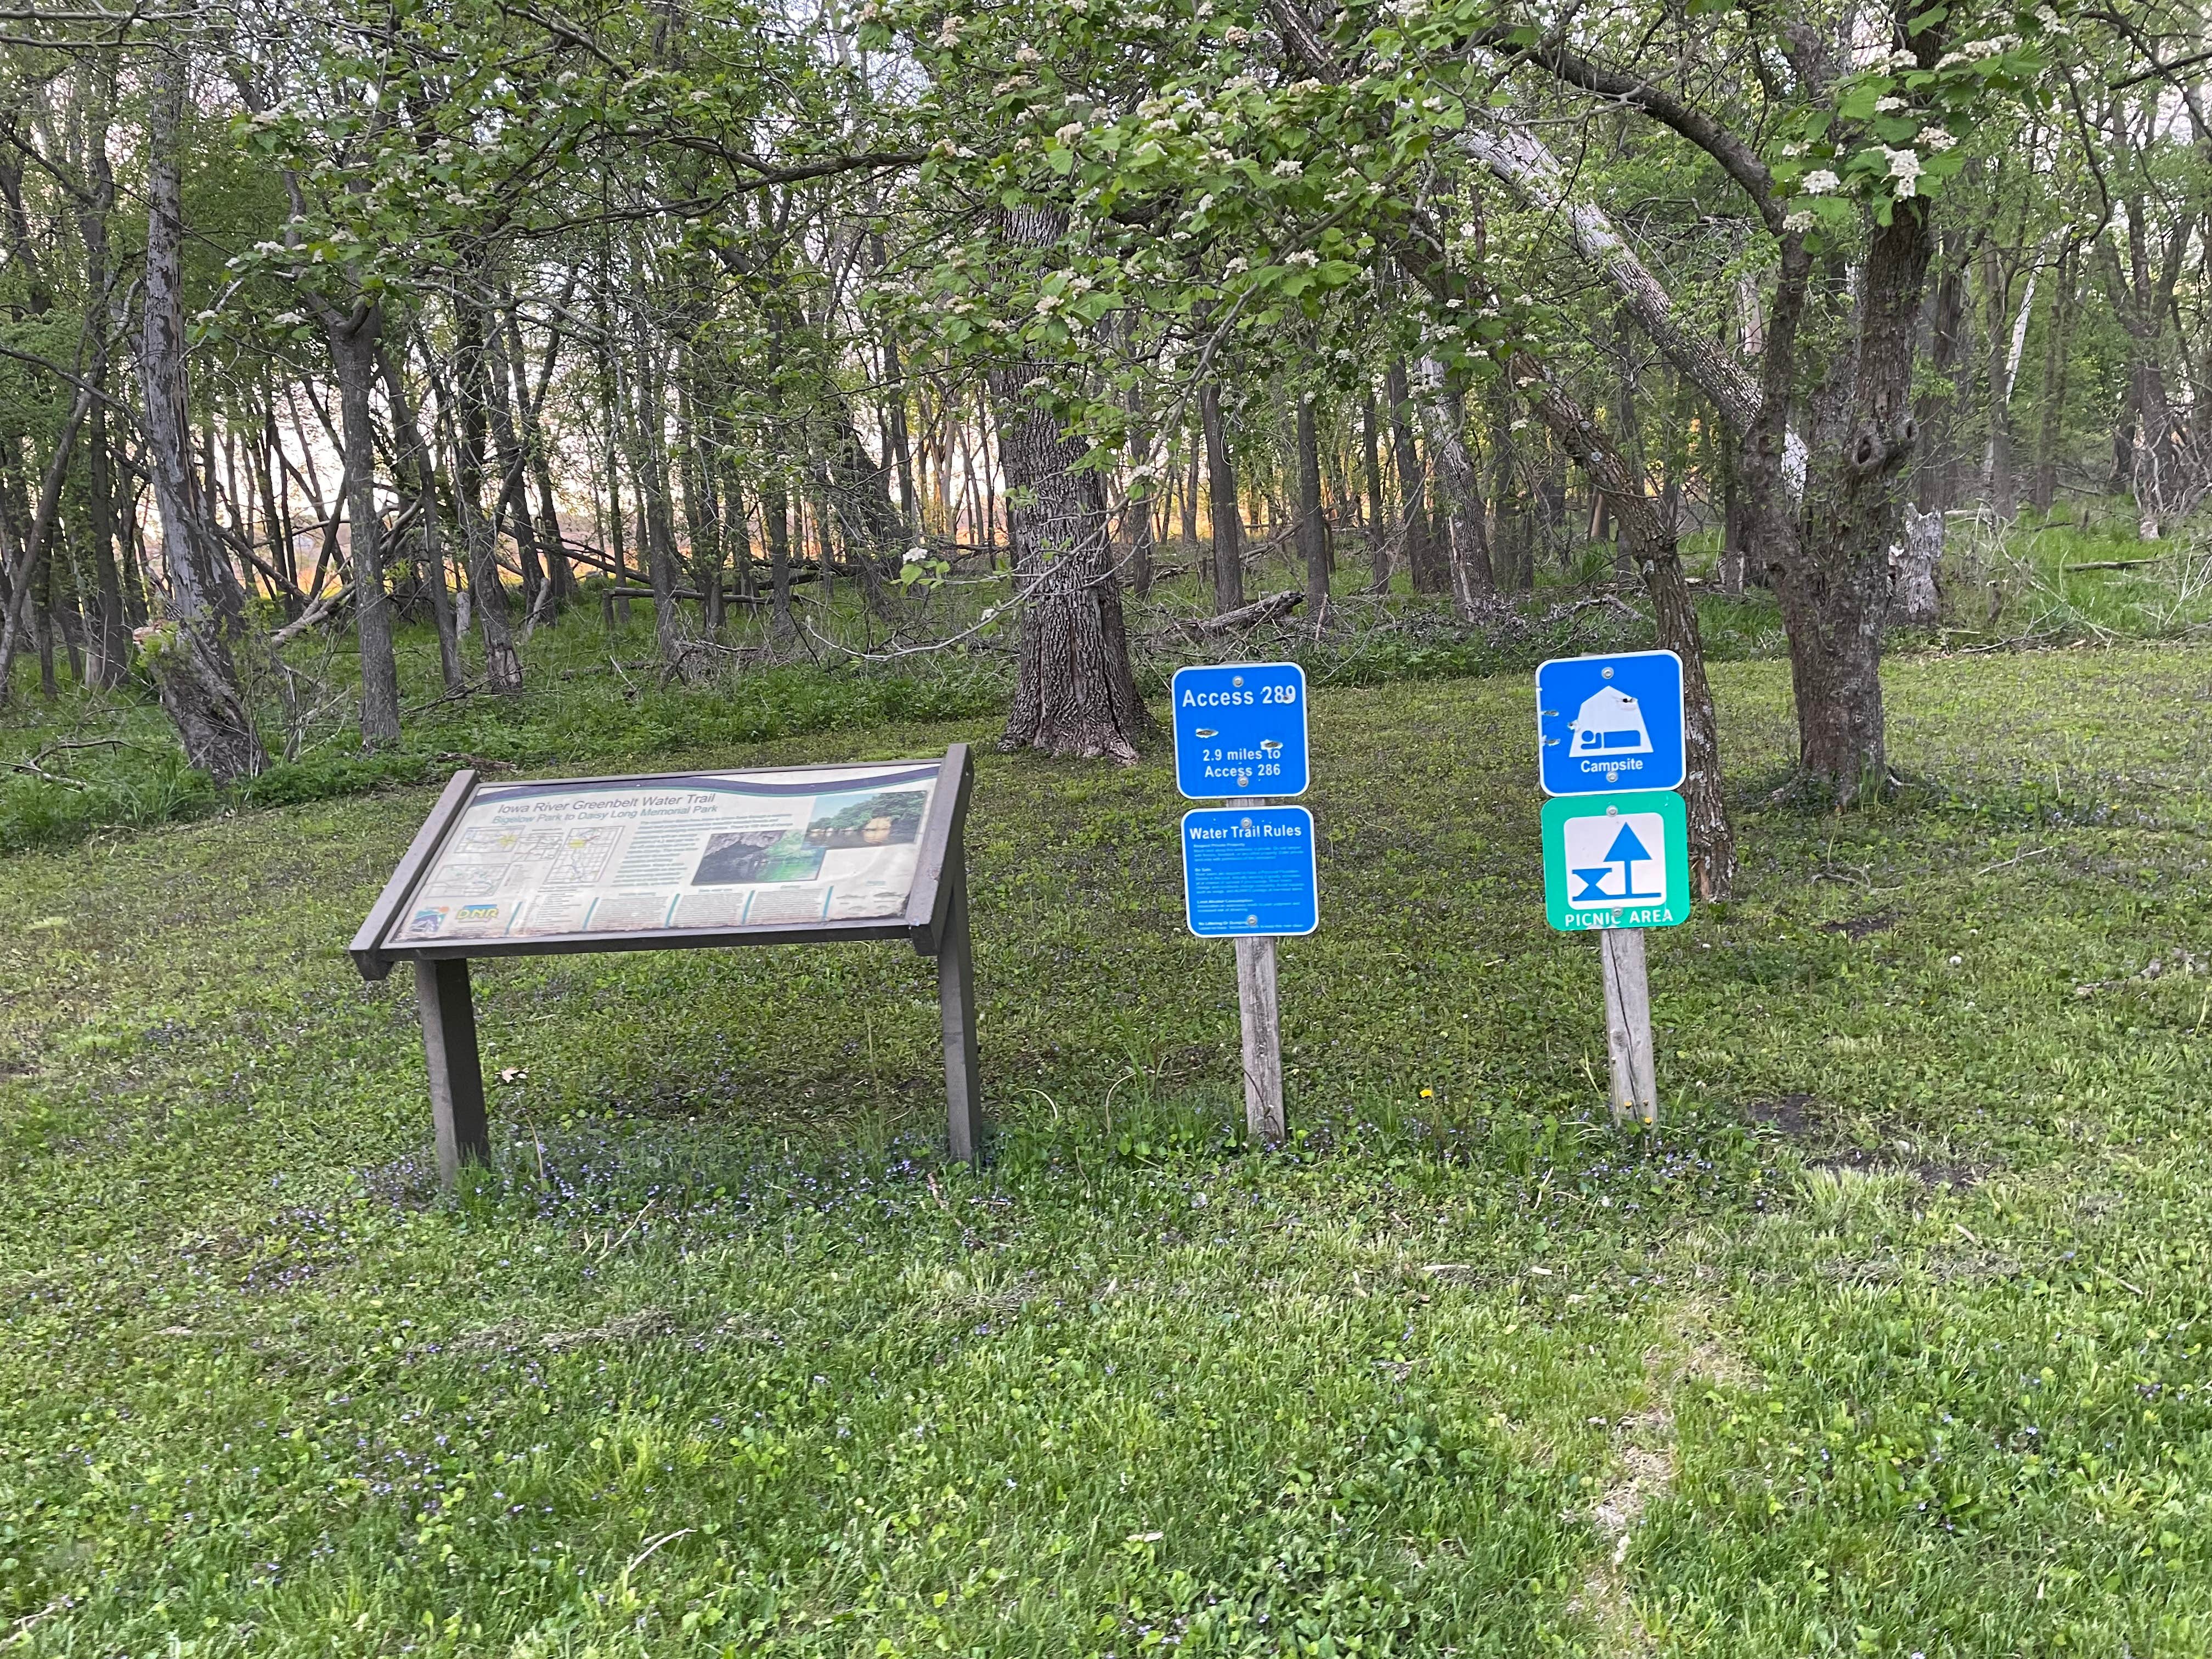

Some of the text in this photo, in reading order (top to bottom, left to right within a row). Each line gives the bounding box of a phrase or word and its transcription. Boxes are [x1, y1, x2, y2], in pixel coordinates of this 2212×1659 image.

[1182, 685, 1296, 707] Access 289
[1203, 748, 1281, 761] 2.9 miles to
[1204, 764, 1281, 778] Access 286
[1581, 758, 1644, 773] Campsite
[498, 793, 716, 814] Iowa River Greenbelt Water Trail
[492, 815, 535, 826] Bigelow
[536, 813, 563, 822] Park
[577, 811, 608, 821] Daisy
[610, 810, 638, 819] Long
[640, 806, 691, 817] Memorial
[692, 805, 719, 814] Park
[1189, 825, 1302, 840] Water Trail Rules
[455, 908, 500, 920] DNR
[1565, 909, 1674, 927] PICNIC AREA
